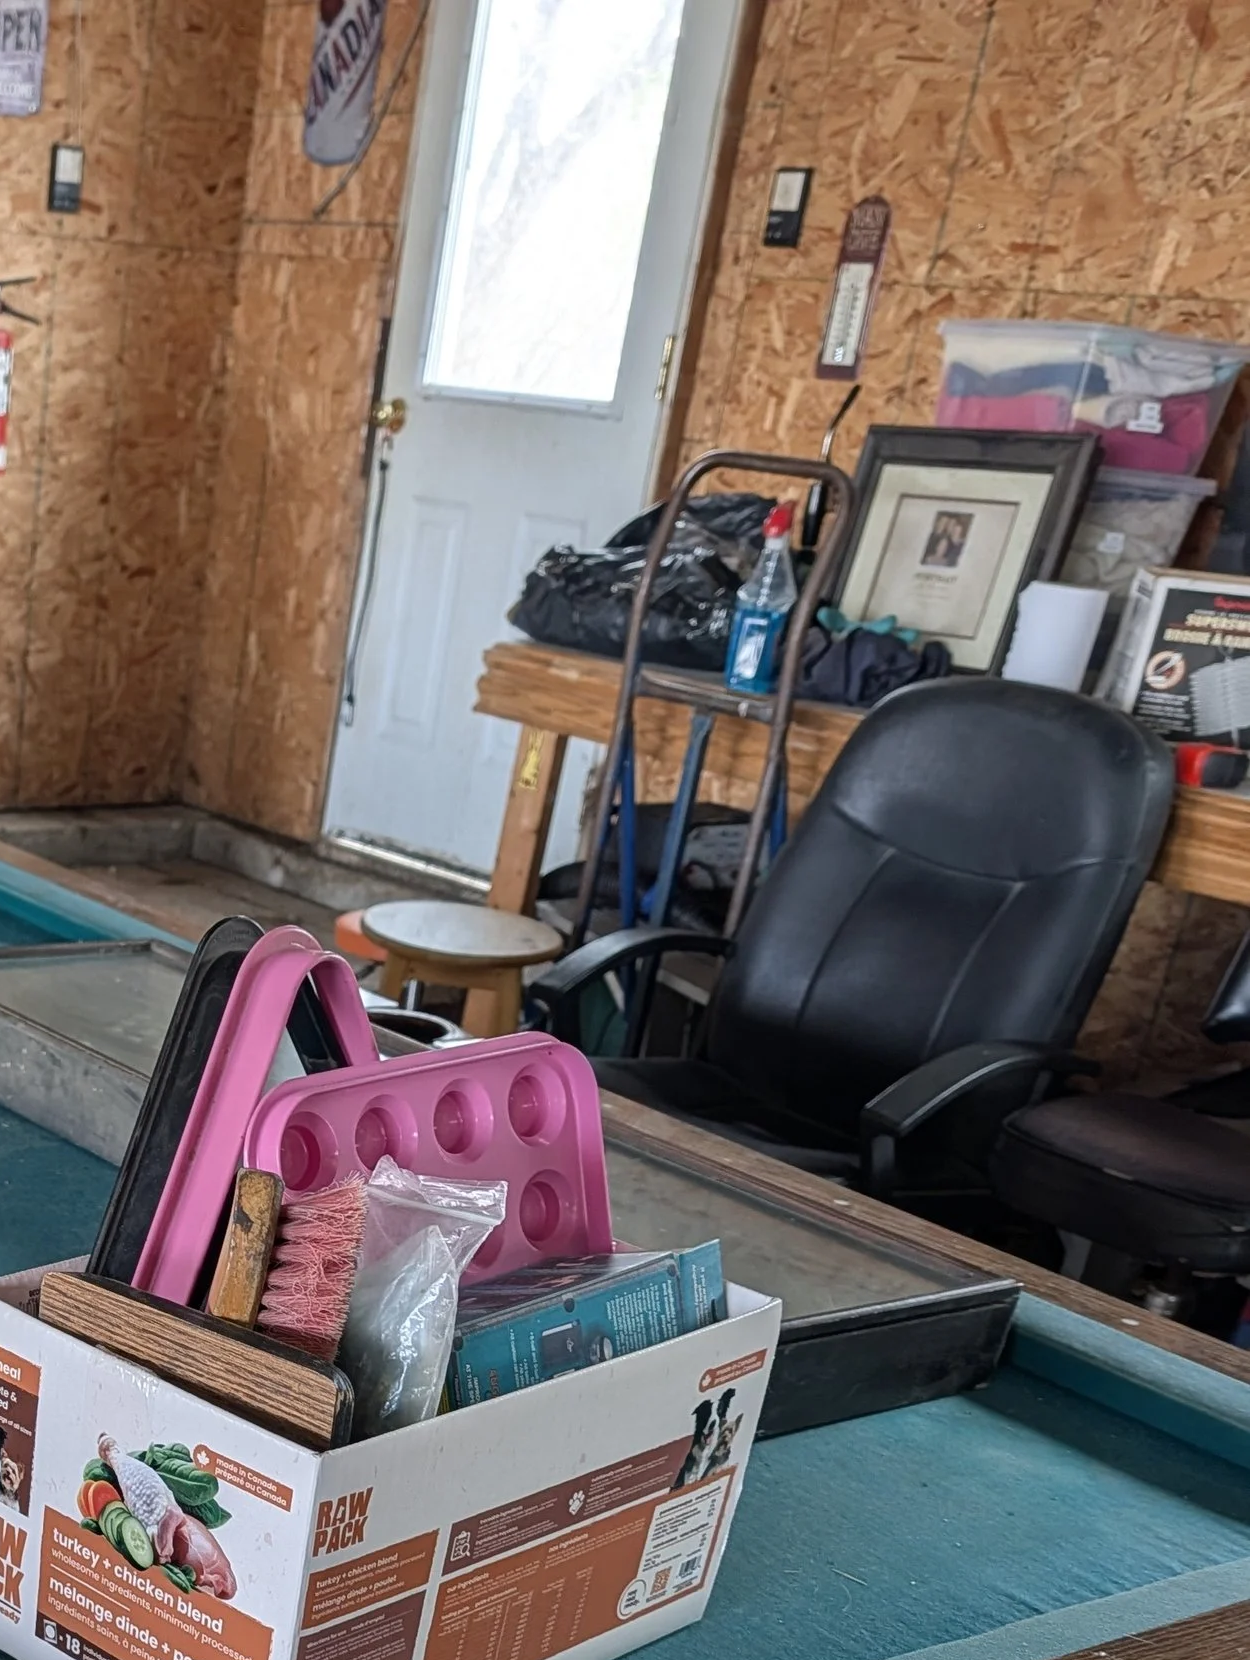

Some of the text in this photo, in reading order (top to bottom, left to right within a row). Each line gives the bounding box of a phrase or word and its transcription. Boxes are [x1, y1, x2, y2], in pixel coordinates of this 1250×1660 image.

[10, 1391, 18, 1403] &
[214, 1467, 287, 1506] préparé au Canada
[216, 1458, 277, 1492] made in Canada
[316, 1487, 373, 1530] RAW
[312, 1516, 368, 1557] PACK
[53, 1527, 100, 1568] turkey
[114, 1565, 174, 1608] chicken
[177, 1595, 223, 1635] blend
[316, 1575, 341, 1588] turkey
[347, 1562, 377, 1578] chicken
[377, 1552, 399, 1567] blend
[49, 1577, 113, 1623] mélange
[115, 1614, 159, 1649] dinde
[51, 1548, 100, 1581] wholesome
[101, 1574, 153, 1613] ingredients,
[154, 1607, 201, 1640] minimally
[312, 1594, 346, 1612] mélange
[347, 1586, 368, 1600] dinde
[373, 1574, 397, 1591] poulet
[48, 1593, 95, 1629] ingrédients
[96, 1625, 121, 1645] sains,
[122, 1640, 129, 1649] à
[65, 1633, 81, 1655] 18
